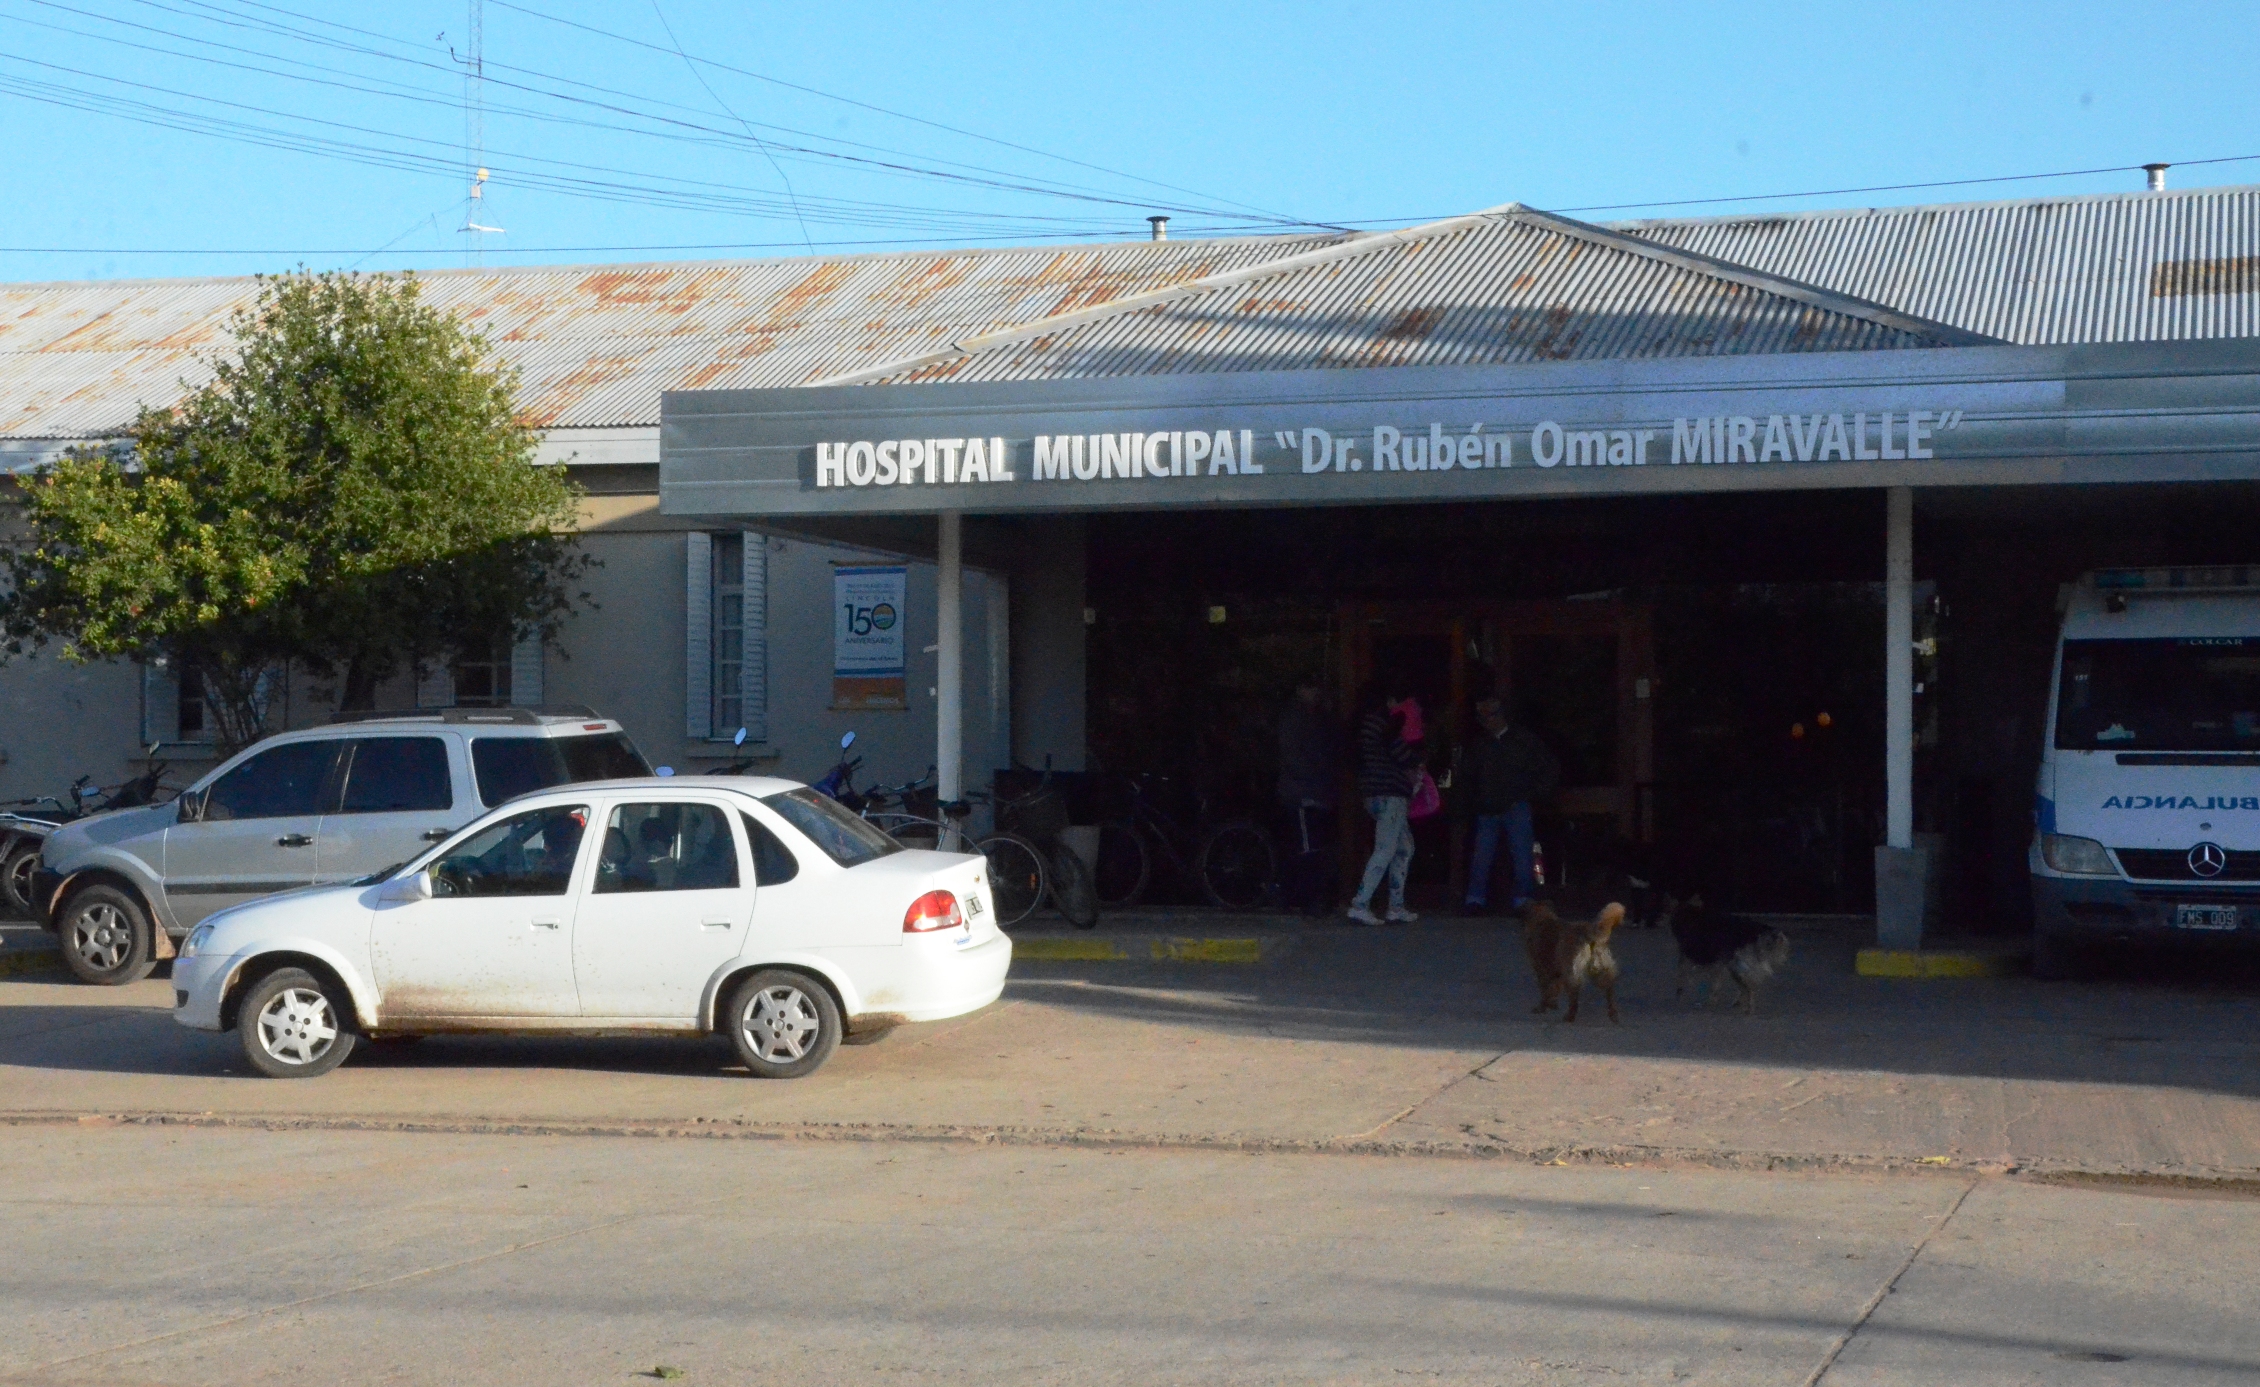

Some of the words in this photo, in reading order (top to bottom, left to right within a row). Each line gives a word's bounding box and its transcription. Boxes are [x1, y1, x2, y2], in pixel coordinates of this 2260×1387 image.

[816, 437, 1013, 487] HOSPITAL
[1032, 429, 1264, 480] MUNICIPAL
[1373, 422, 1511, 471] Rubén
[1531, 421, 1655, 468] Omar
[843, 603, 897, 636] 150
[845, 637, 894, 645] ANIVERSARIO
